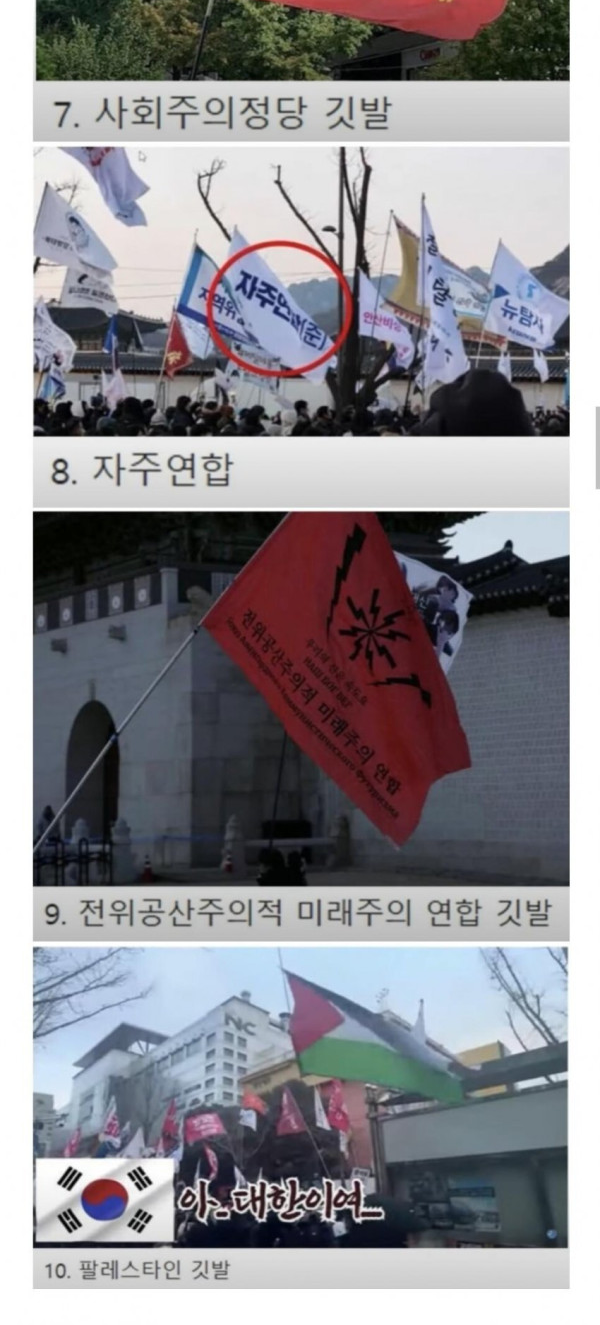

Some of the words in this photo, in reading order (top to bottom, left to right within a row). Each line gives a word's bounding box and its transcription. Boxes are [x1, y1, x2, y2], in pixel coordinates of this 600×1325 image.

[500, 298, 544, 336] 뉴탐사
[242, 608, 319, 706] 전위공산주의적
[317, 702, 376, 765] 미래주의
[374, 762, 401, 796] 연합
[224, 1012, 256, 1036] NC
